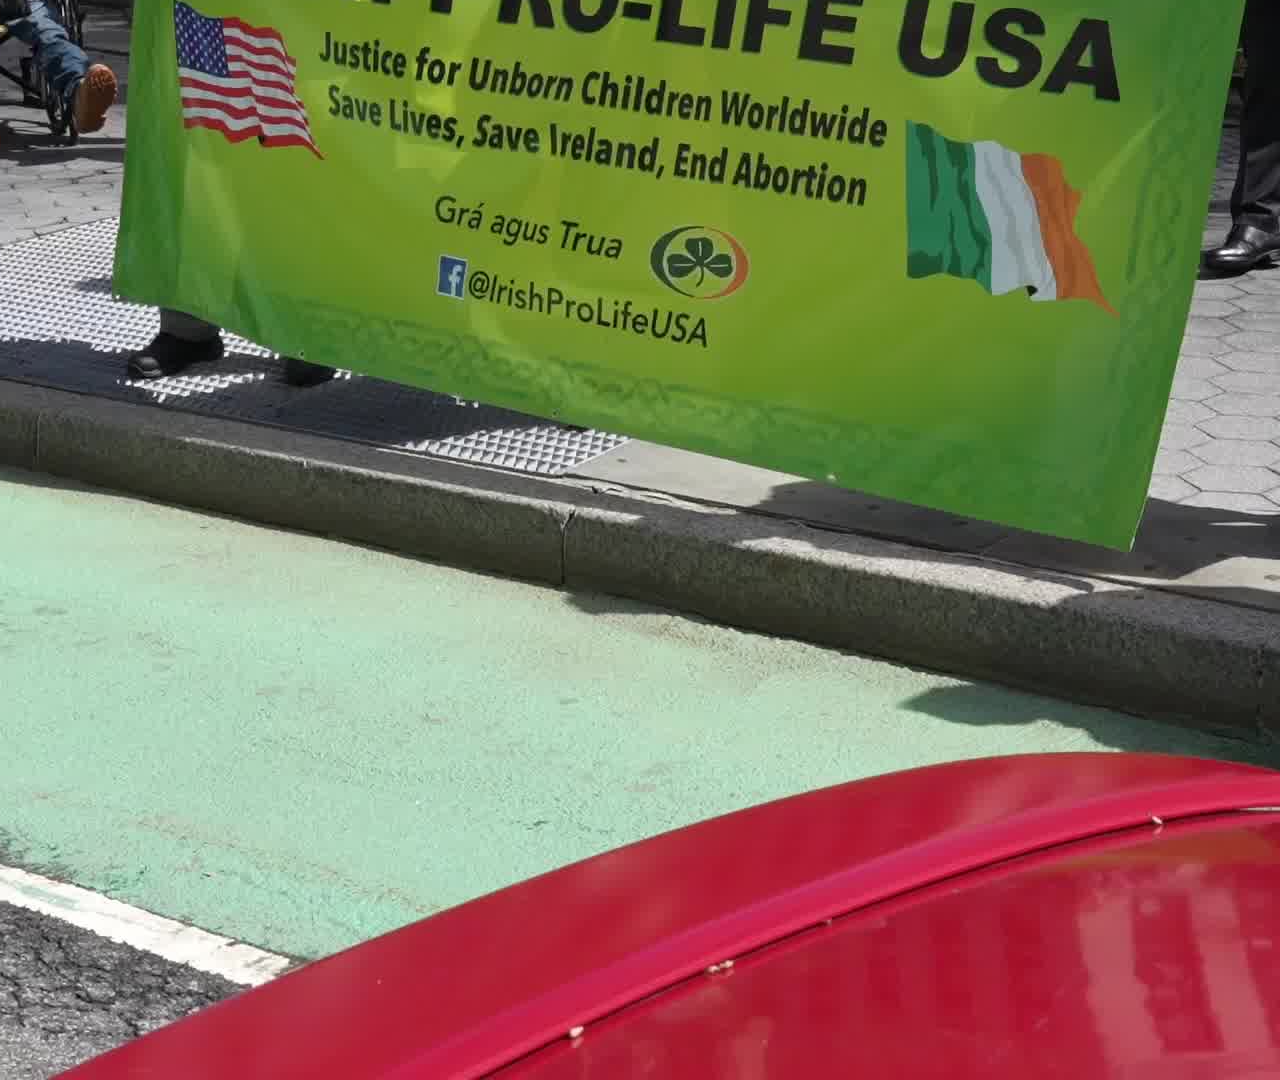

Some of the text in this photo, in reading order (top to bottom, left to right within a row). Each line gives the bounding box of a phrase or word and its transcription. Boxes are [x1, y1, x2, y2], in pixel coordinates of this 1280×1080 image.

[319, 32, 888, 148] Justice for Unborn Children Worldwide
[328, 86, 867, 207] Save Lives, Save Ireland, End Abortion
[435, 195, 624, 260] Grá agus Trua
[468, 270, 708, 348] @IrishProLifeUSA
